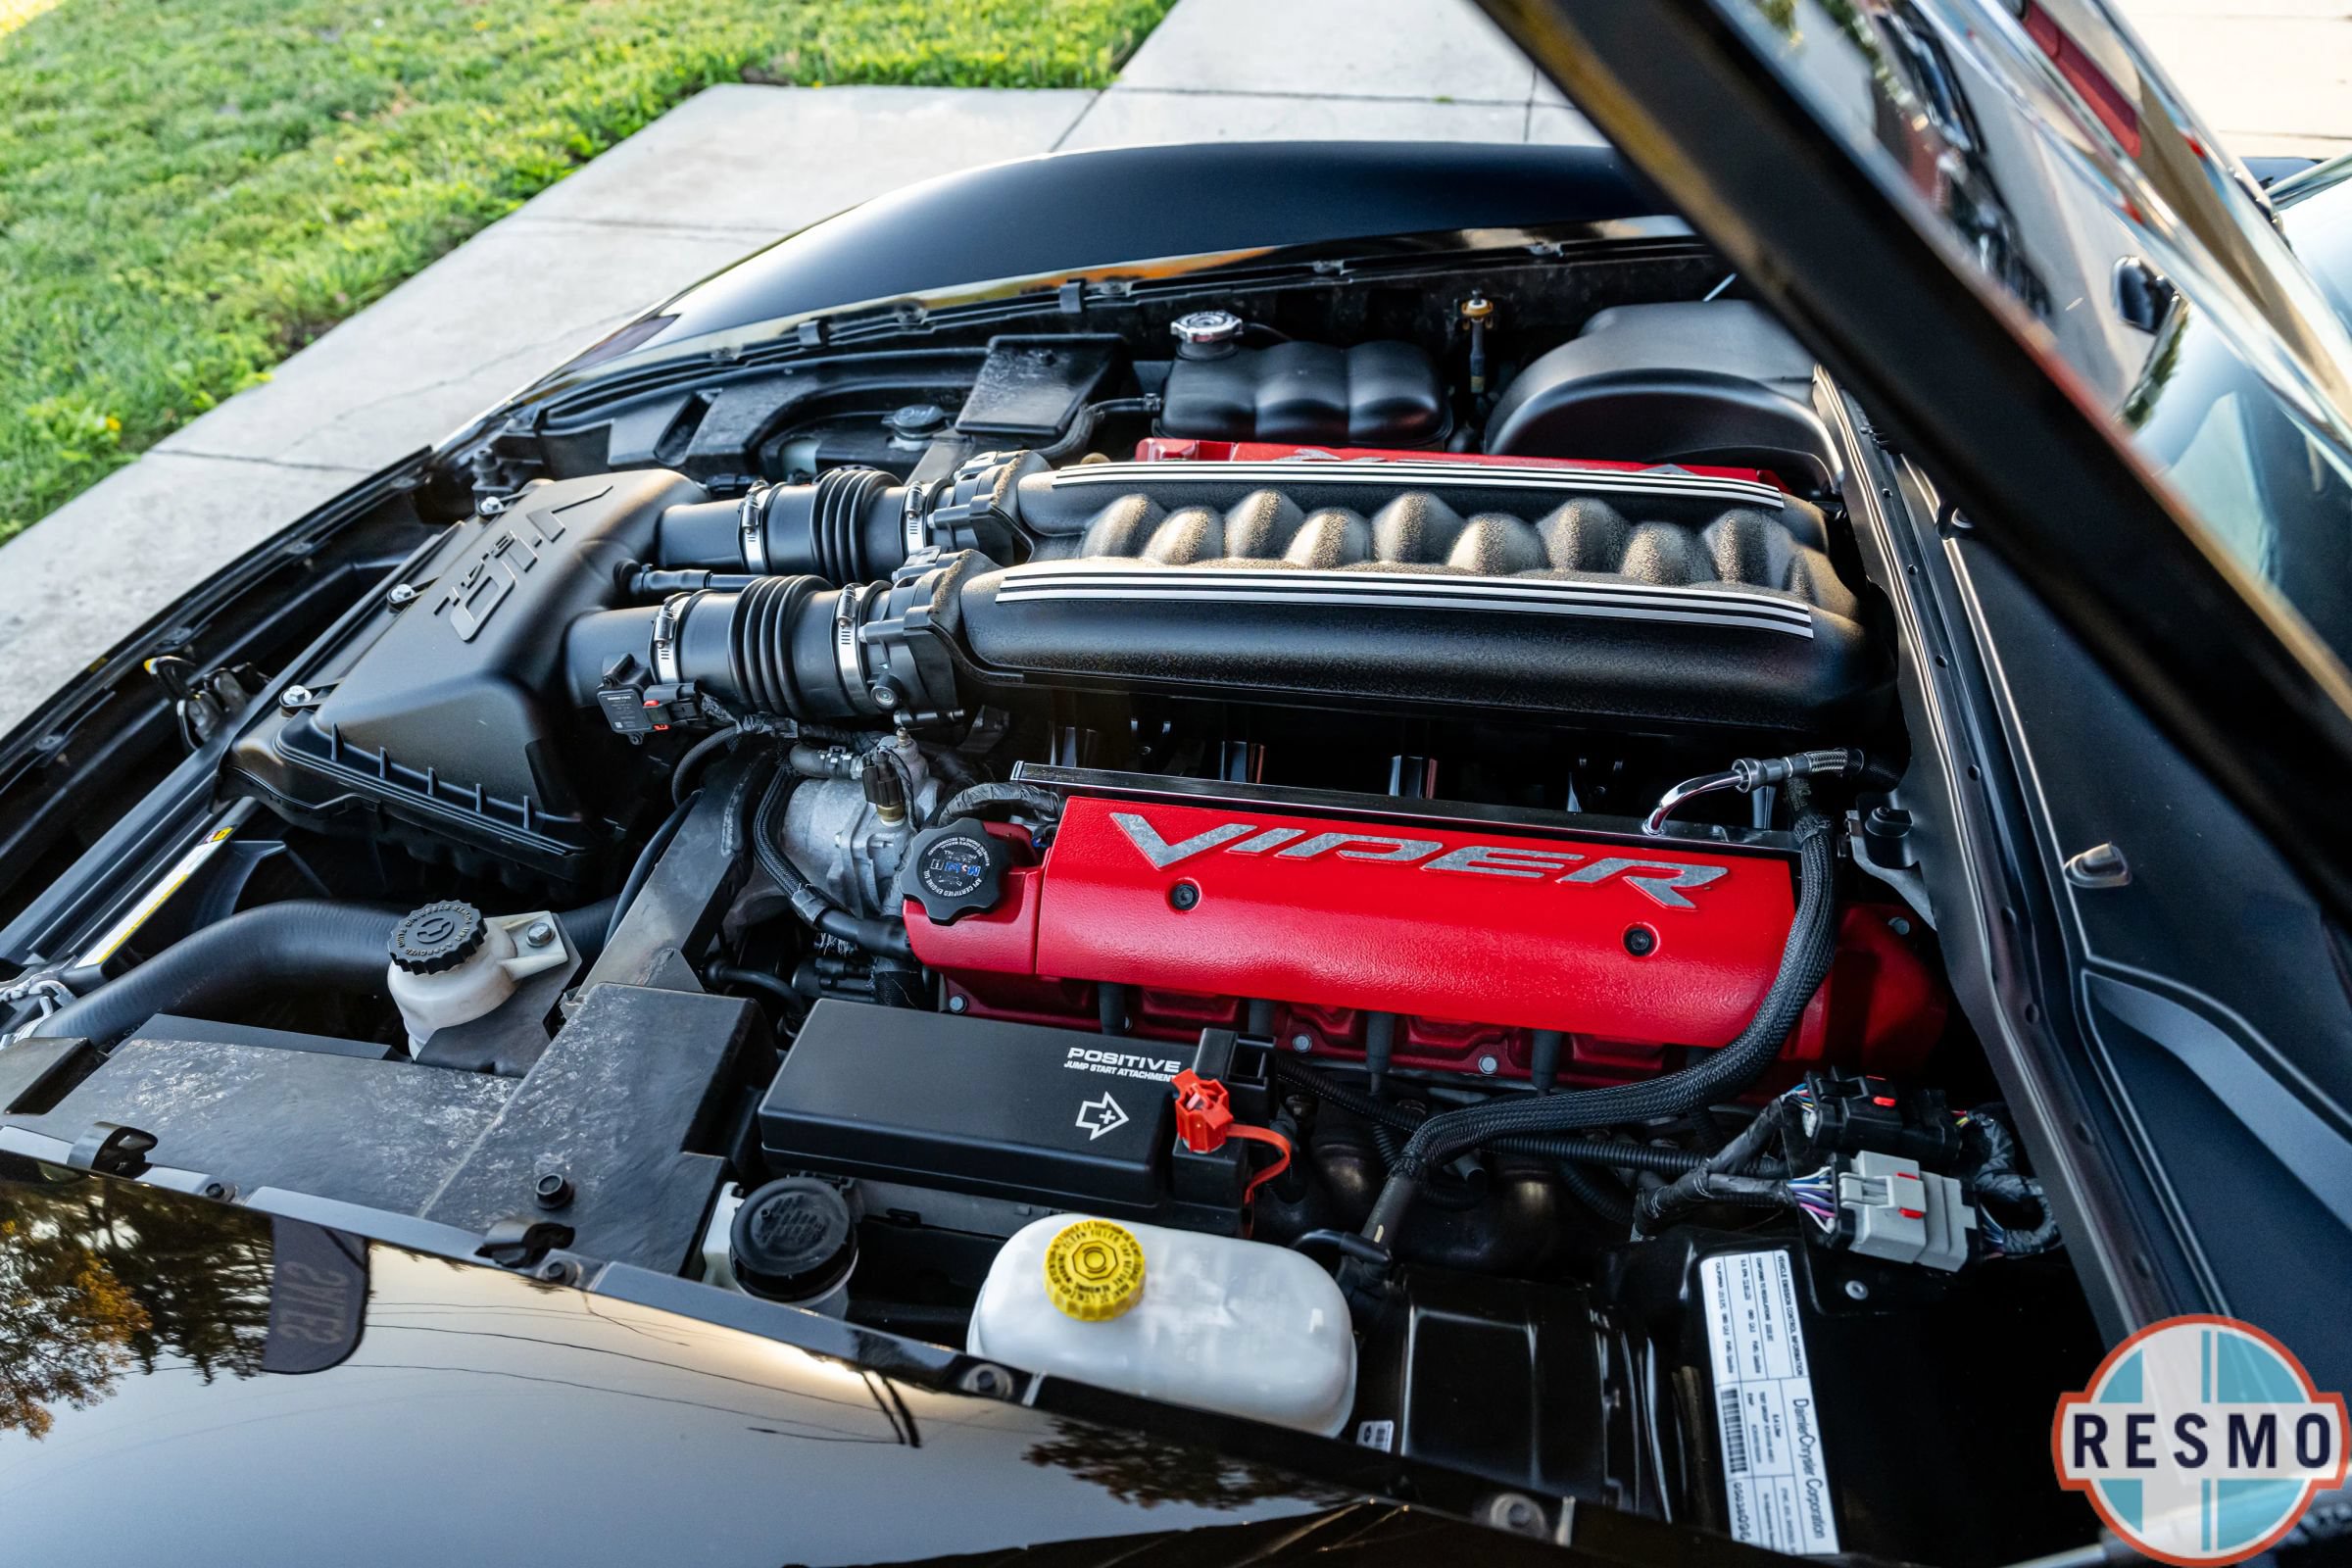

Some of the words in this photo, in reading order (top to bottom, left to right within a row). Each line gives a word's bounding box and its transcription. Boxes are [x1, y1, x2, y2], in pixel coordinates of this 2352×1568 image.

[1109, 811, 1729, 910] VIPER
[926, 878, 944, 895] ENGINE
[944, 886, 973, 897] CERTIFIED
[972, 878, 982, 888] API
[406, 904, 452, 927] STEERING
[406, 942, 453, 956] APPROVED
[1063, 1060, 1089, 1070] JUMP
[1090, 1064, 1117, 1075] START
[1067, 1048, 1181, 1073] POSITIVE
[1778, 1255, 1788, 1278] VEHICLE
[1782, 1279, 1791, 1305] EMISSION
[1787, 1307, 1796, 1334] CONTROL
[1791, 1335, 1804, 1376] INFORMATION
[1792, 1398, 1816, 1476] DaimlerChrysler
[1805, 1478, 1825, 1540] Corporation
